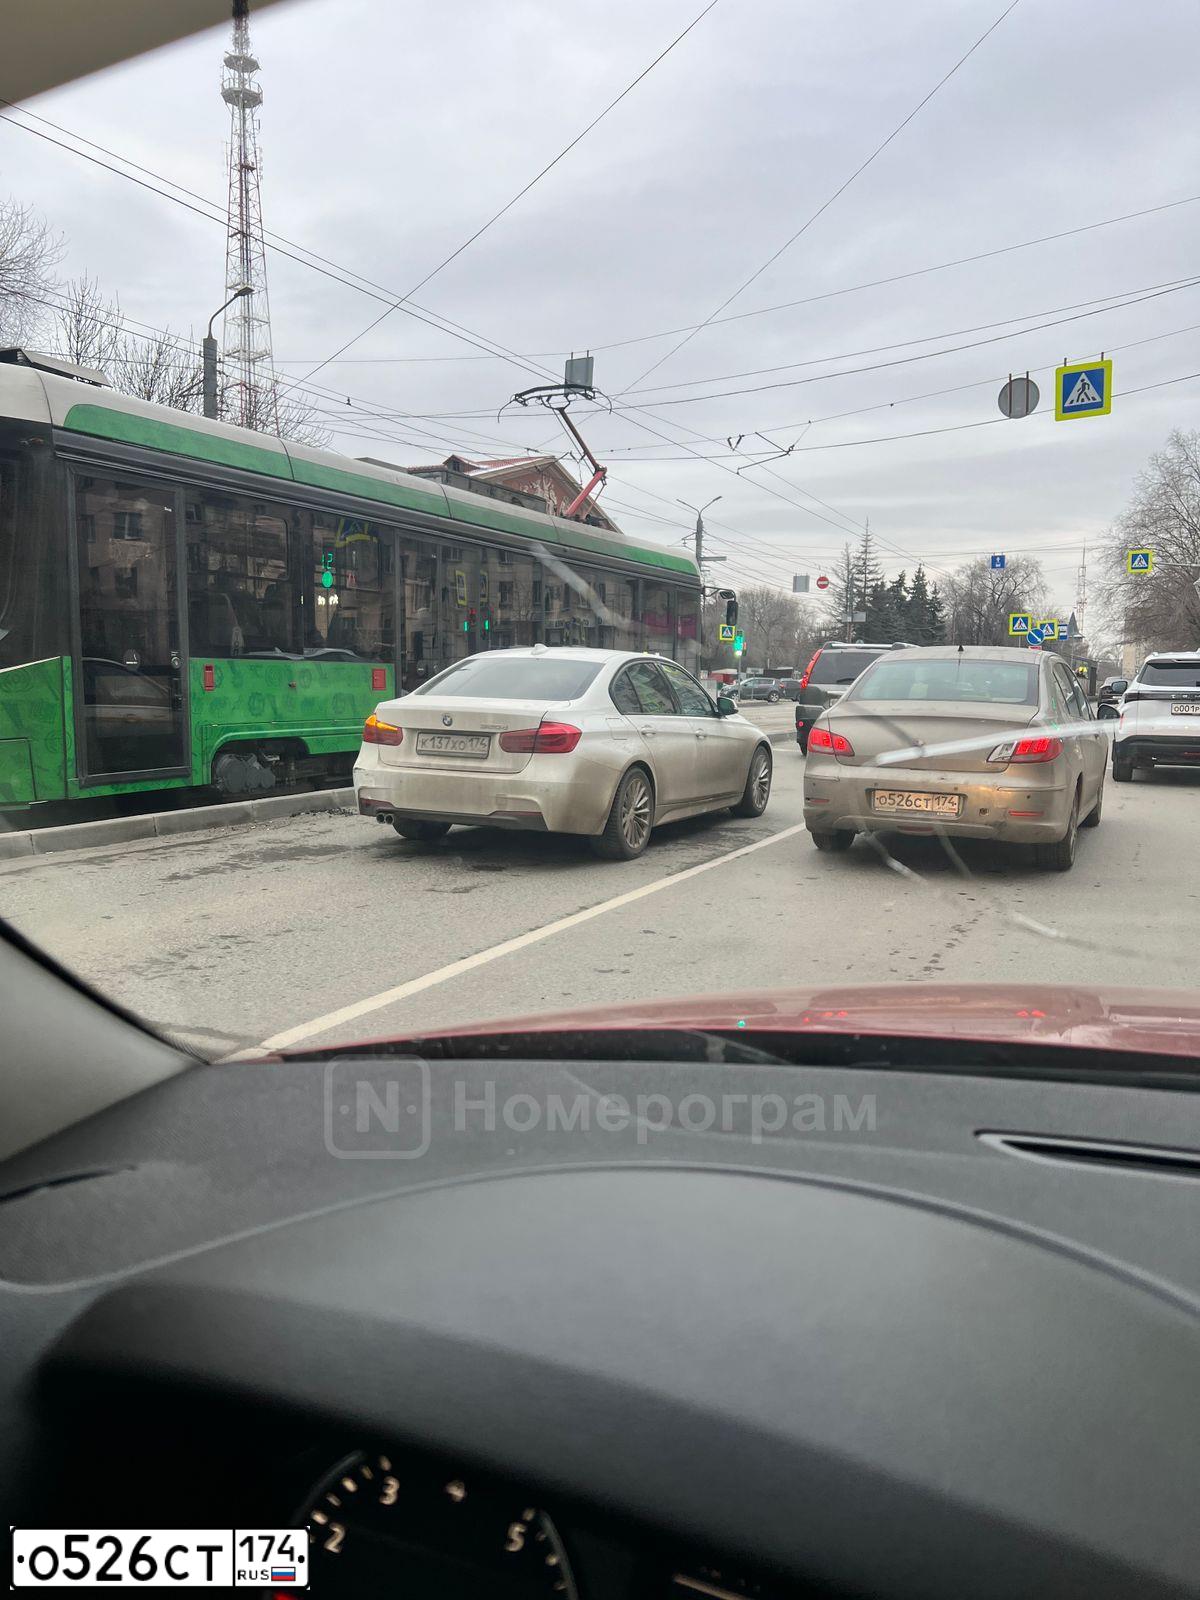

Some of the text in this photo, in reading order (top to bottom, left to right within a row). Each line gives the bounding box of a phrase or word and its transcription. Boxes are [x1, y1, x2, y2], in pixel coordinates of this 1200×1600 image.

[879, 793, 931, 809] О526СТ
[934, 795, 955, 807] 174
[379, 1476, 400, 1506] 3
[324, 1522, 346, 1554] 2
[505, 1521, 527, 1552] 5
